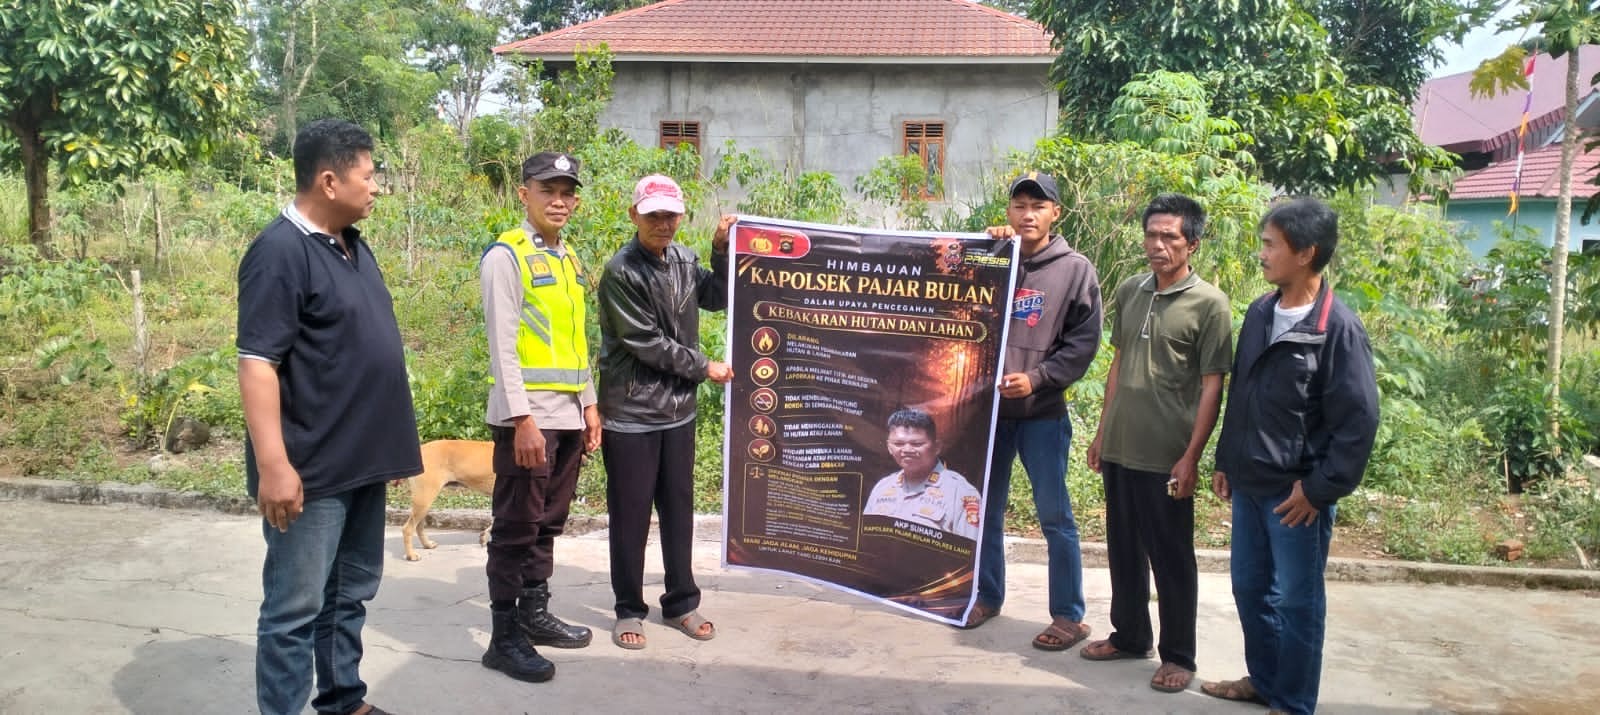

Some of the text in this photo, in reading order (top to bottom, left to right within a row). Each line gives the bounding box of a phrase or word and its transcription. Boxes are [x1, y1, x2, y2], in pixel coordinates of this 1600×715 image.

[827, 259, 922, 276] HIMBAUAN
[964, 255, 1010, 265] PRESISI
[751, 267, 995, 305] KAPOLSEK PAJAR BULAN
[804, 298, 935, 313] DALAM UPAYA PENCEGAHAN
[768, 306, 974, 337] KEBAKARAN HUTAN DAN LAHAN
[787, 333, 819, 344] DILARANG
[785, 373, 815, 381] LAPORKAN
[825, 376, 840, 384] PIHAK
[894, 521, 942, 539] AKP SUHARJO
[913, 533, 931, 543] BULAN
[931, 539, 952, 551] POLRES
[820, 548, 857, 560] KEHIDUPAN
